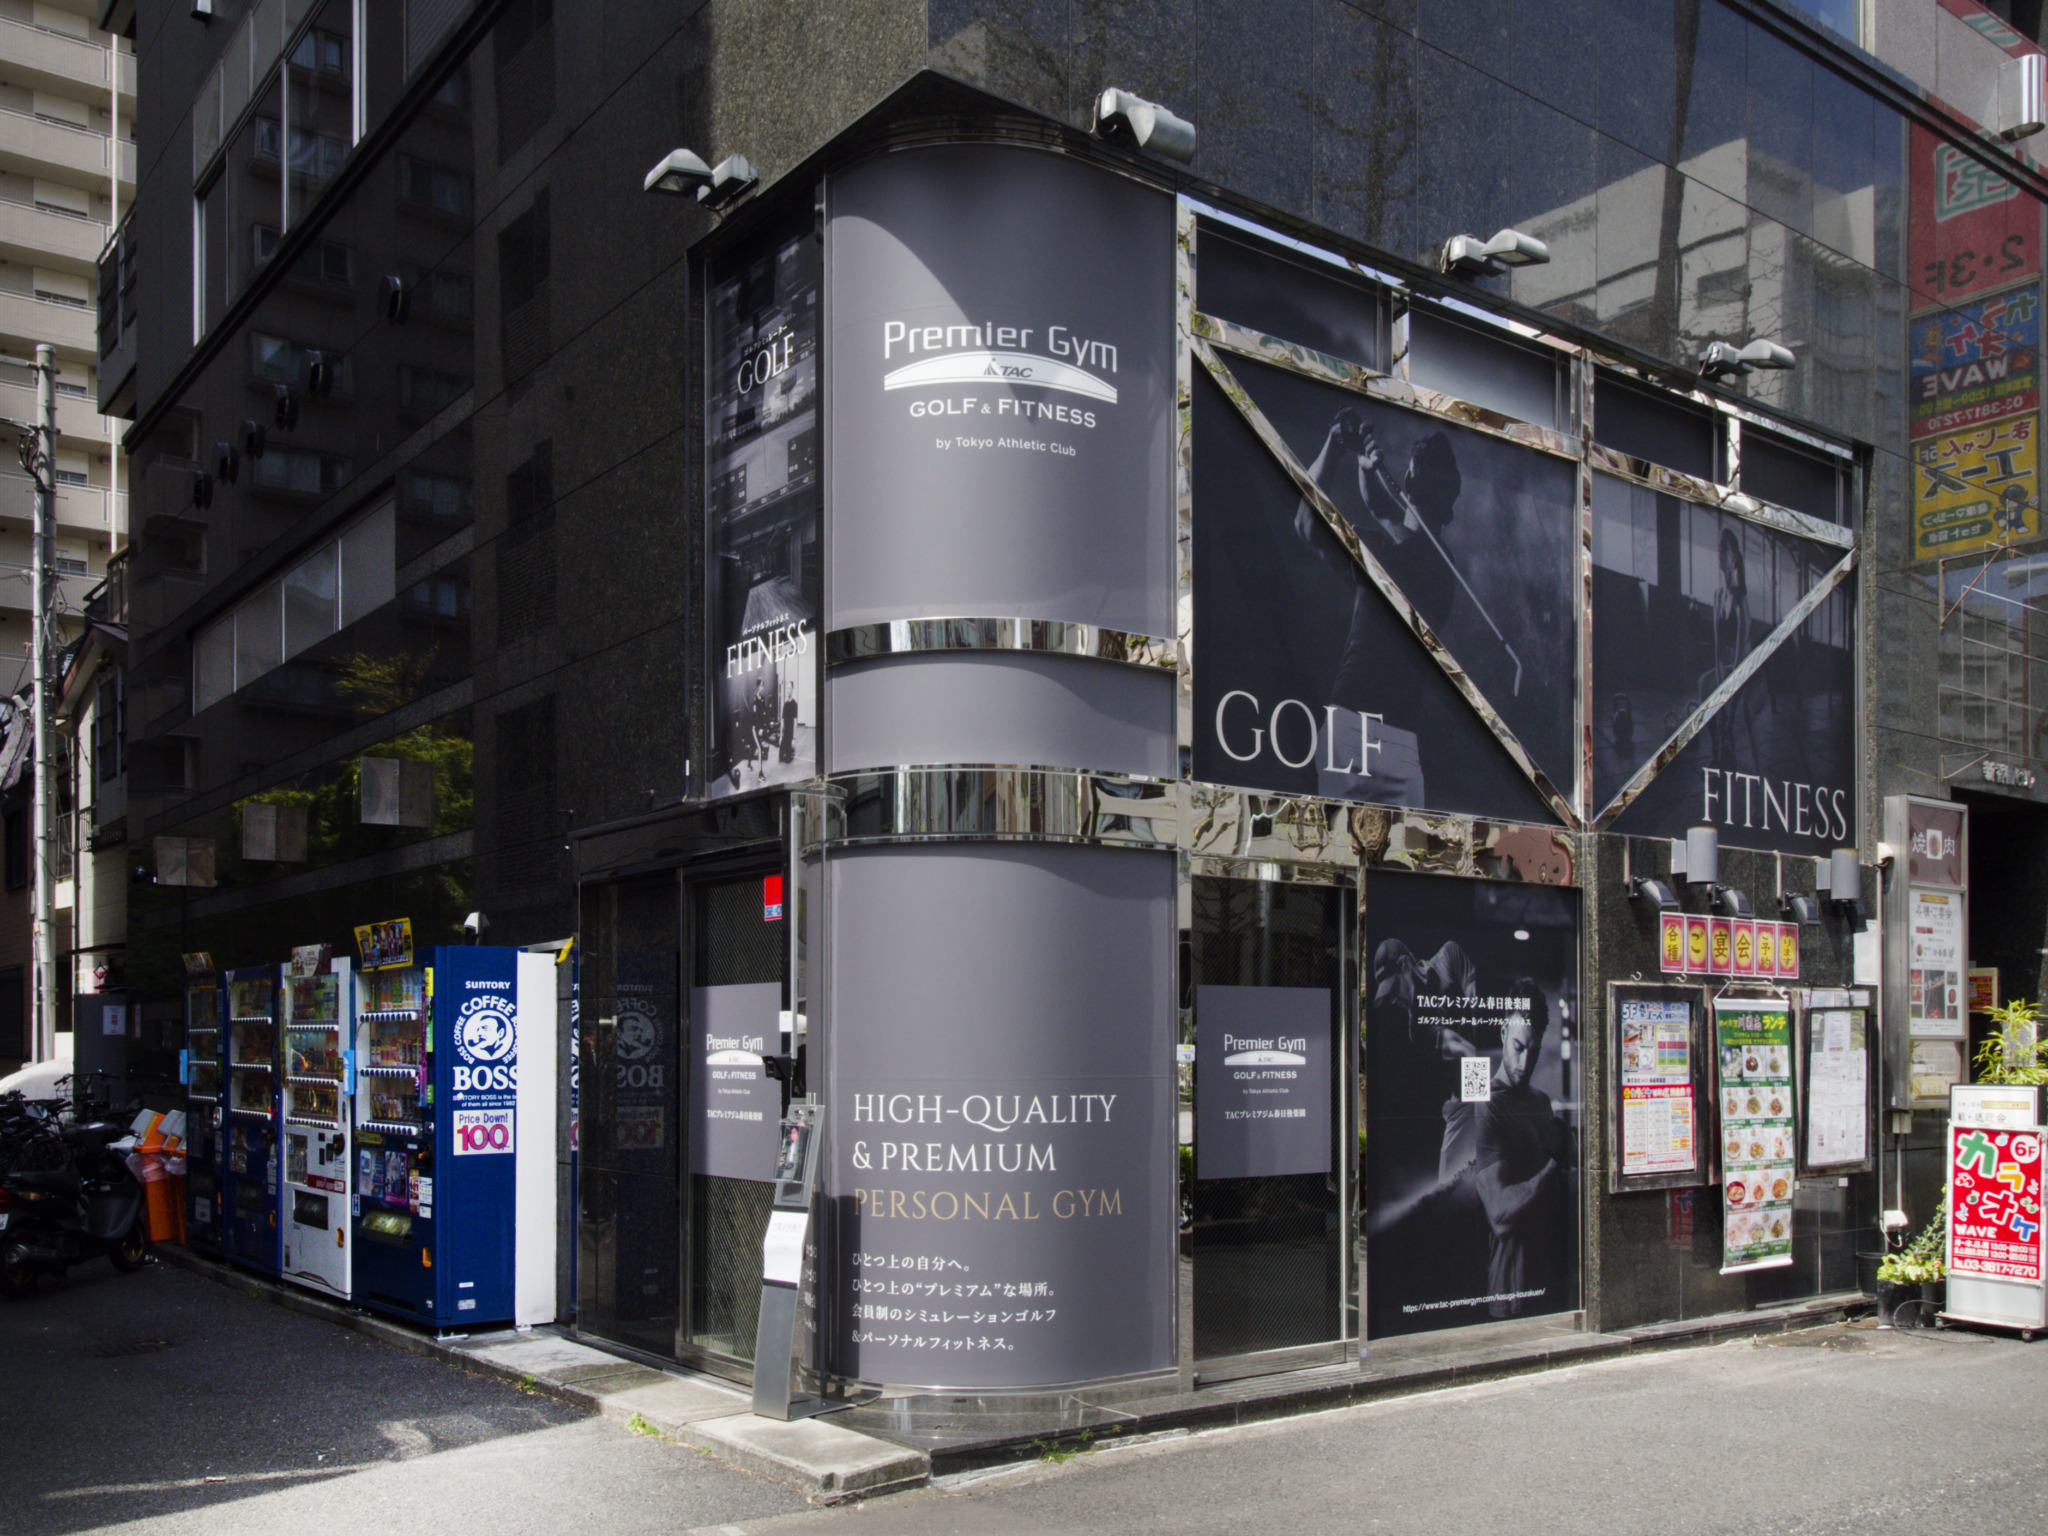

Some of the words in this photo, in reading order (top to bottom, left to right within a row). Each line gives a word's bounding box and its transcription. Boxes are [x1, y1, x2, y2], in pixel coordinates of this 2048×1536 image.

[884, 321, 1034, 360] Premier
[1049, 325, 1118, 373] Gym
[737, 331, 795, 395] GOLF
[998, 365, 1034, 378] TAC
[909, 397, 977, 418] GOLF
[981, 403, 991, 414] &
[999, 398, 1096, 429] FITNESS
[936, 438, 951, 451] by
[955, 436, 993, 450] Tokyo
[997, 437, 1046, 452] Athletic
[1050, 442, 1076, 457] Club
[726, 618, 807, 679] FITNESS
[1215, 690, 1384, 778] GOLF
[1701, 766, 1847, 842] FITNESS
[465, 980, 511, 989] SUNTORY
[460, 995, 516, 1017] COFFEE
[1622, 1003, 1637, 1019] 5F
[706, 1033, 740, 1051] Premier
[743, 1034, 763, 1052] Gym
[1224, 1033, 1274, 1052] Premier
[1278, 1035, 1306, 1053] Gym
[453, 1066, 517, 1091] BOSS
[712, 1071, 728, 1080] GOLF
[731, 1071, 757, 1080] FITNESS
[1234, 1072, 1256, 1080] GOLF
[1262, 1071, 1298, 1079] FITNESS
[459, 1113, 480, 1124] Price
[483, 1112, 508, 1124] Down!
[853, 1093, 1117, 1132] HIGH-QUALITY
[457, 1123, 509, 1151] 100
[852, 1141, 873, 1170] &
[881, 1142, 1057, 1172] PREMIUM
[2014, 1140, 2037, 1157] 6F
[853, 1188, 1040, 1220] PERSONAL
[1052, 1188, 1123, 1219] GYM
[1954, 1223, 1998, 1239] WAVE
[852, 1253, 970, 1272] ひとつ上の自分へ。
[852, 1302, 1056, 1323] 会員制のシミュレーションゴルフ
[852, 1328, 1014, 1351] &パーソナルフィットネス。
